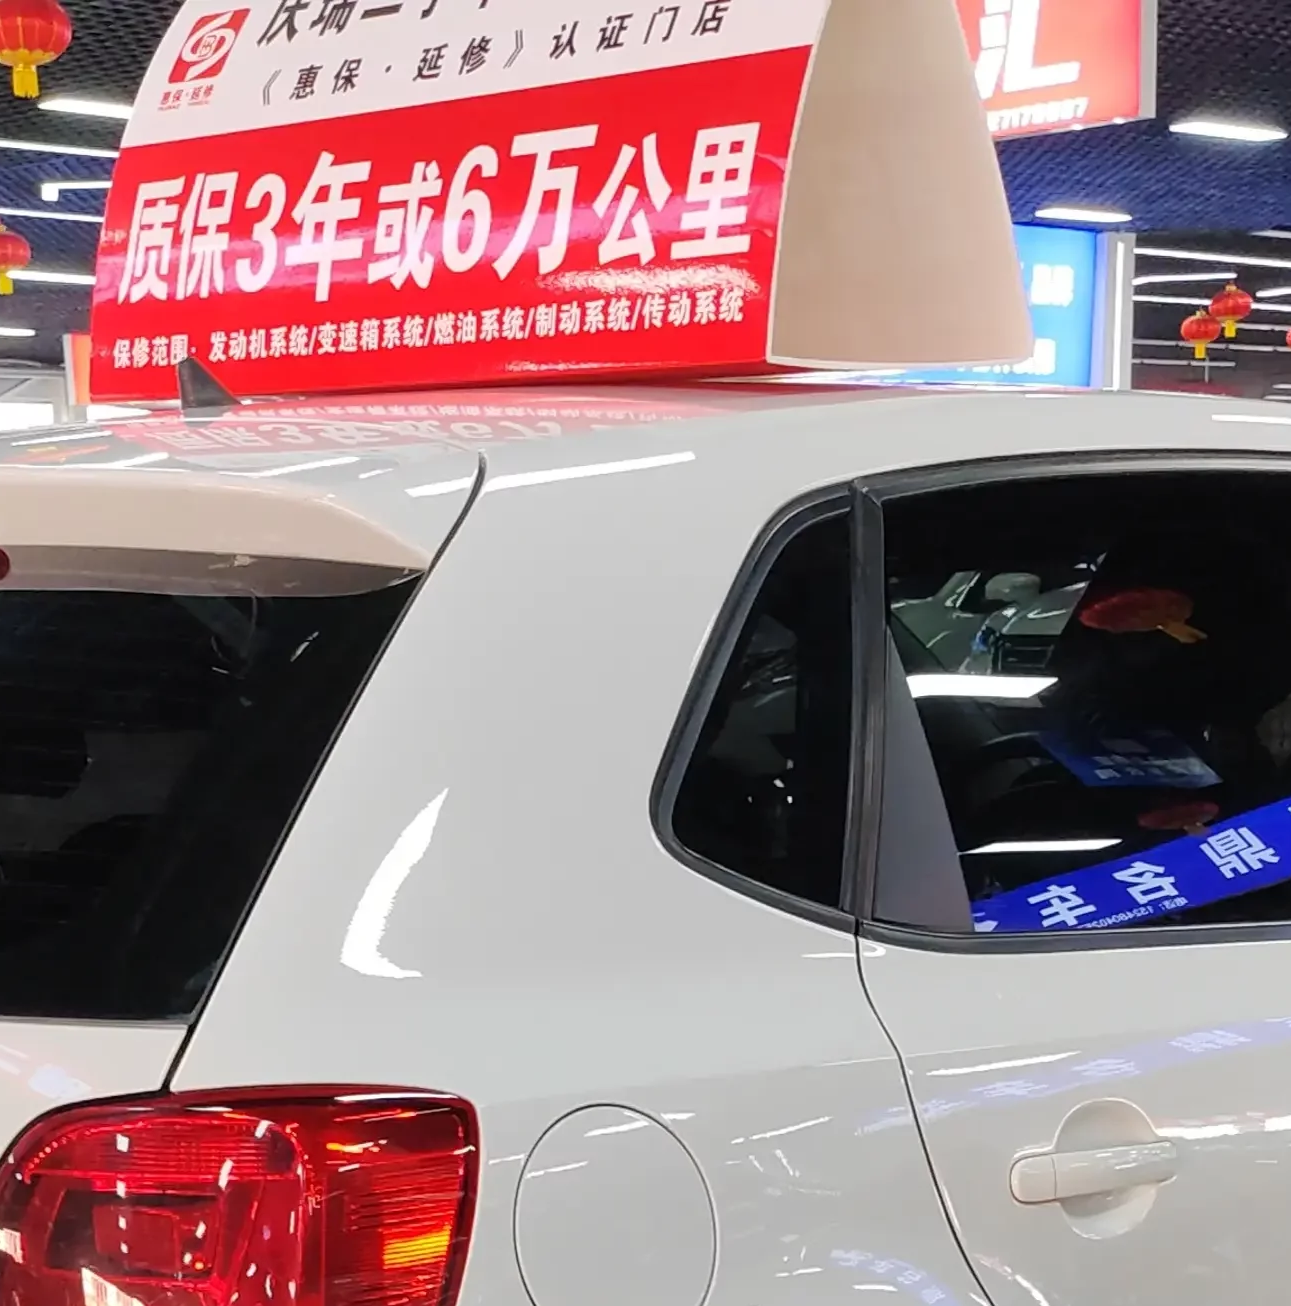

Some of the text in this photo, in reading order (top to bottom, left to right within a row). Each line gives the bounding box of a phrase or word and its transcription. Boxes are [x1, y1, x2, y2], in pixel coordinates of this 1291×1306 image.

[117, 121, 761, 305] 质保3年或6万公里
